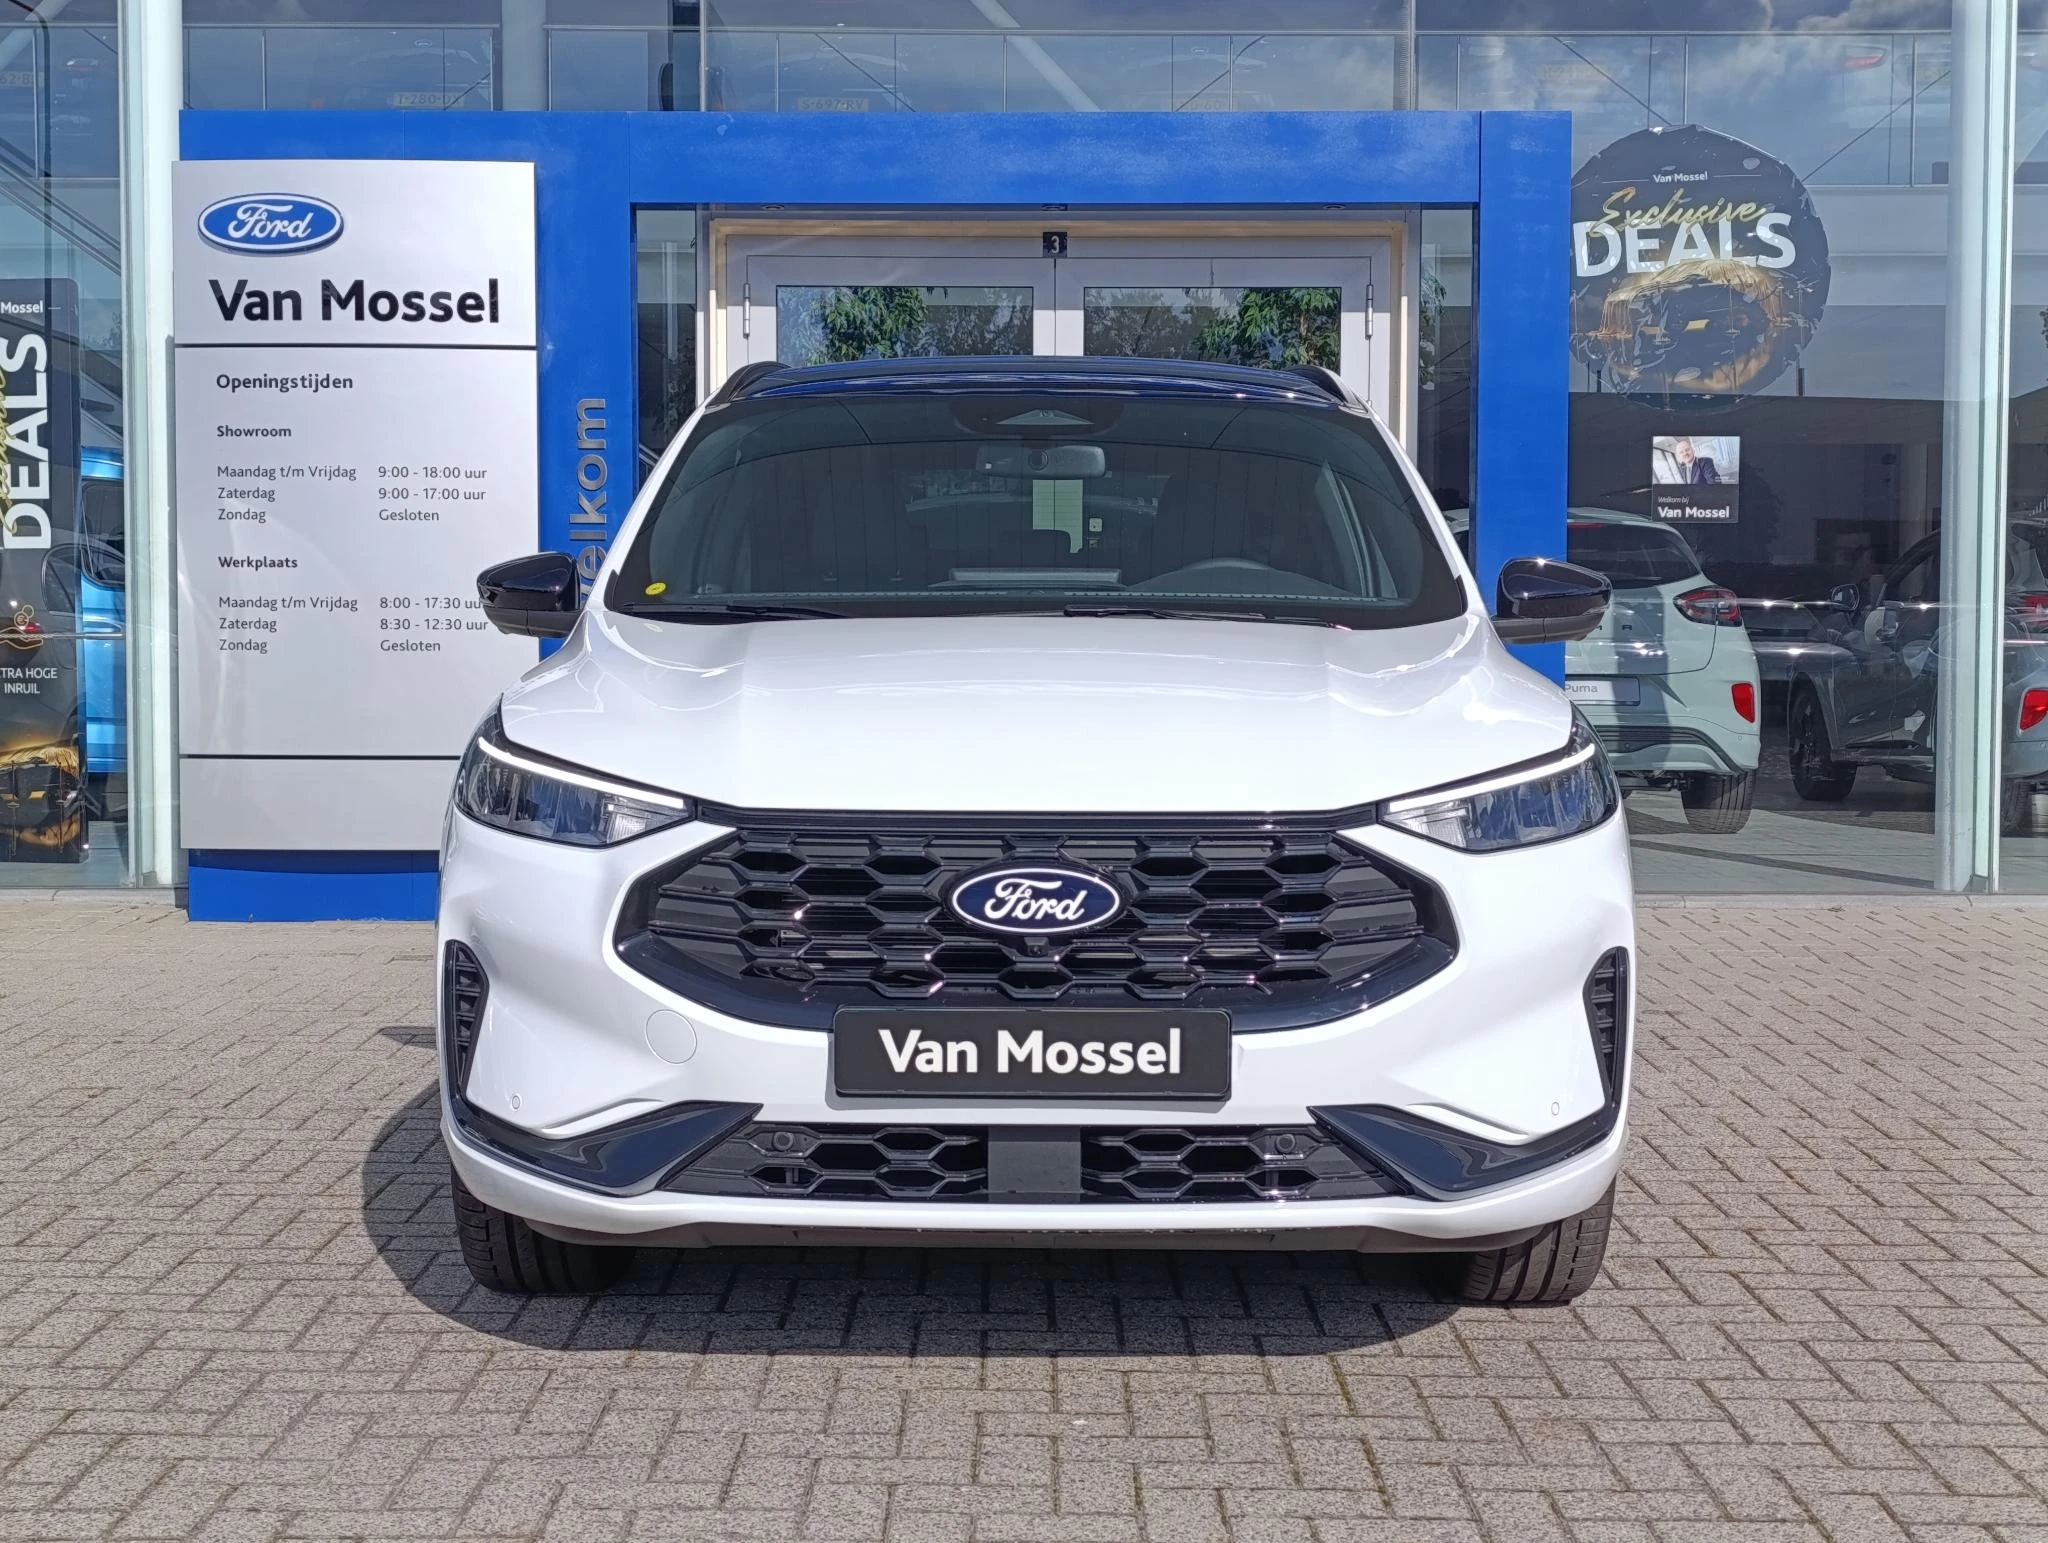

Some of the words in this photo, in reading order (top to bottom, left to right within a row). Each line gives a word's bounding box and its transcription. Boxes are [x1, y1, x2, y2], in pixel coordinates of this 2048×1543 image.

[1653, 174, 1673, 183] Van
[1674, 171, 1708, 182] Mossel
[1589, 186, 1767, 238] Exclusive
[227, 203, 314, 239] Ford
[1051, 235, 1060, 253] 3
[1573, 212, 1797, 277] DEALS
[0, 301, 43, 314] Mossel
[208, 279, 302, 321] Van
[321, 278, 499, 324] Mossel
[216, 373, 353, 393] Openingstijden
[216, 425, 292, 437] Showroom
[0, 333, 51, 549] DEALS
[217, 465, 276, 481] Maandag
[280, 465, 305, 478] t/m
[309, 465, 357, 482] Vrijdag
[378, 466, 409, 478] 9:00
[422, 466, 461, 479] 18:00
[464, 469, 488, 479] uur
[218, 487, 276, 502] Zaterdag
[378, 487, 409, 500] 9:00
[423, 488, 460, 500] 17:00
[464, 490, 486, 500] uur
[218, 508, 267, 524] Zondag
[379, 509, 440, 521] Gesloten
[1658, 506, 1682, 518] Van
[1685, 506, 1730, 518] Mossel
[218, 556, 298, 571] Werkplaats
[218, 596, 278, 611] Maandag
[281, 597, 306, 609] t/m
[310, 596, 358, 612] Vrijdag
[380, 597, 410, 609] 8:00
[424, 597, 461, 609] 17:30
[219, 618, 277, 633] Zaterdag
[380, 618, 410, 630] 8:30
[424, 618, 462, 630] 12:30
[466, 621, 489, 630] uur
[219, 639, 268, 654] Zondag
[380, 639, 441, 651] Gesloten
[0, 668, 23, 679] TRA
[26, 667, 58, 679] HOGE
[4, 682, 41, 694] INRUIL
[984, 877, 1088, 921] Ford
[878, 1028, 978, 1074] Van
[997, 1027, 1181, 1074] Mossel
